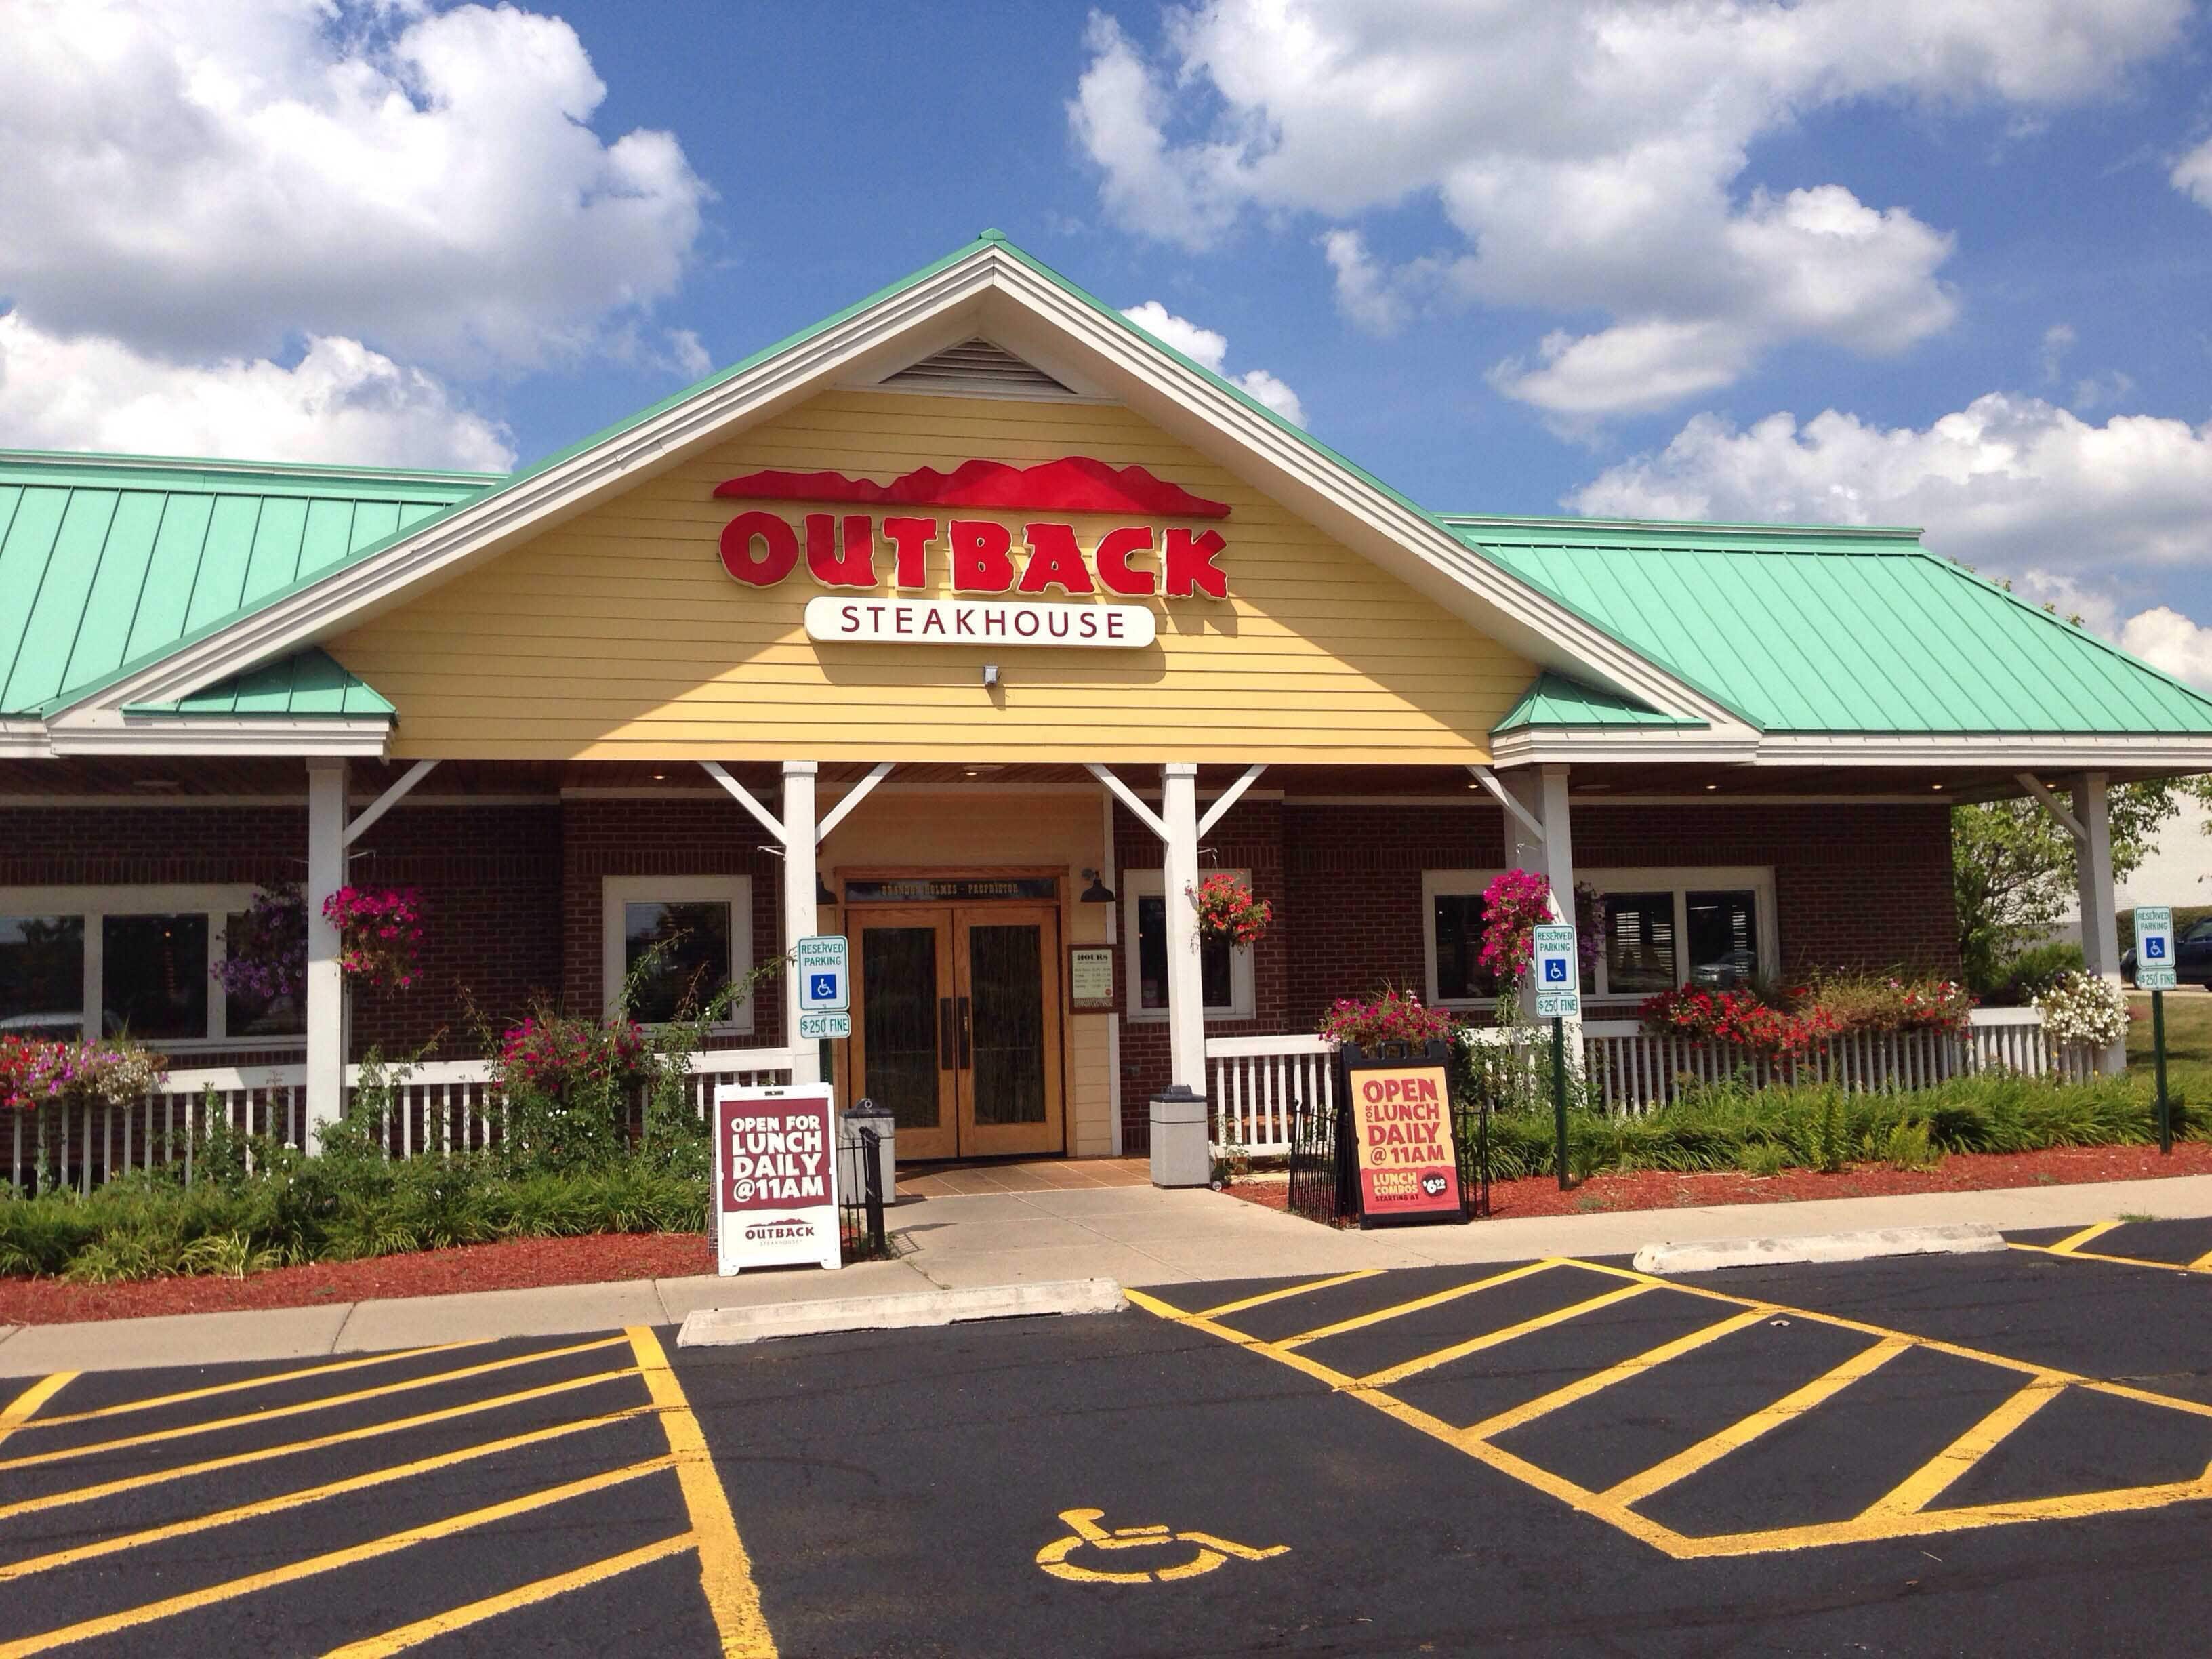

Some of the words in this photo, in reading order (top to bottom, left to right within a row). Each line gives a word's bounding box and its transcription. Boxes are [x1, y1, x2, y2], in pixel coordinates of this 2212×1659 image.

[718, 511, 1229, 600] OUTBACK
[840, 605, 1126, 639] STEAKHOUSE
[922, 884, 957, 895] HOLMES
[2137, 912, 2169, 921] RESERVED
[2141, 922, 2169, 930] PARKING
[1537, 932, 1573, 941] RESERVED
[801, 943, 844, 954] RESERVED
[1540, 943, 1571, 951] PARKING
[804, 956, 842, 967] PARKING
[2160, 974, 2175, 985] FINE
[1538, 1000, 1558, 1012] $250
[1561, 999, 1577, 1012] FINE
[802, 1019, 826, 1033] $250
[830, 1018, 848, 1033] FINE
[1362, 1078, 1439, 1103] OPEN
[1365, 1105, 1374, 1122] FOR
[1373, 1103, 1440, 1122] LUNCH
[731, 1116, 780, 1133] OPEN
[786, 1115, 821, 1131] FOR
[1367, 1122, 1441, 1146] DAILY
[732, 1130, 823, 1156] LUNCH
[733, 1153, 823, 1180] DAILY
[1372, 1172, 1418, 1186] LUNCH
[733, 1176, 825, 1203] @11AM
[1374, 1185, 1418, 1195] COMBOS
[745, 1227, 815, 1240] OUTBACK
